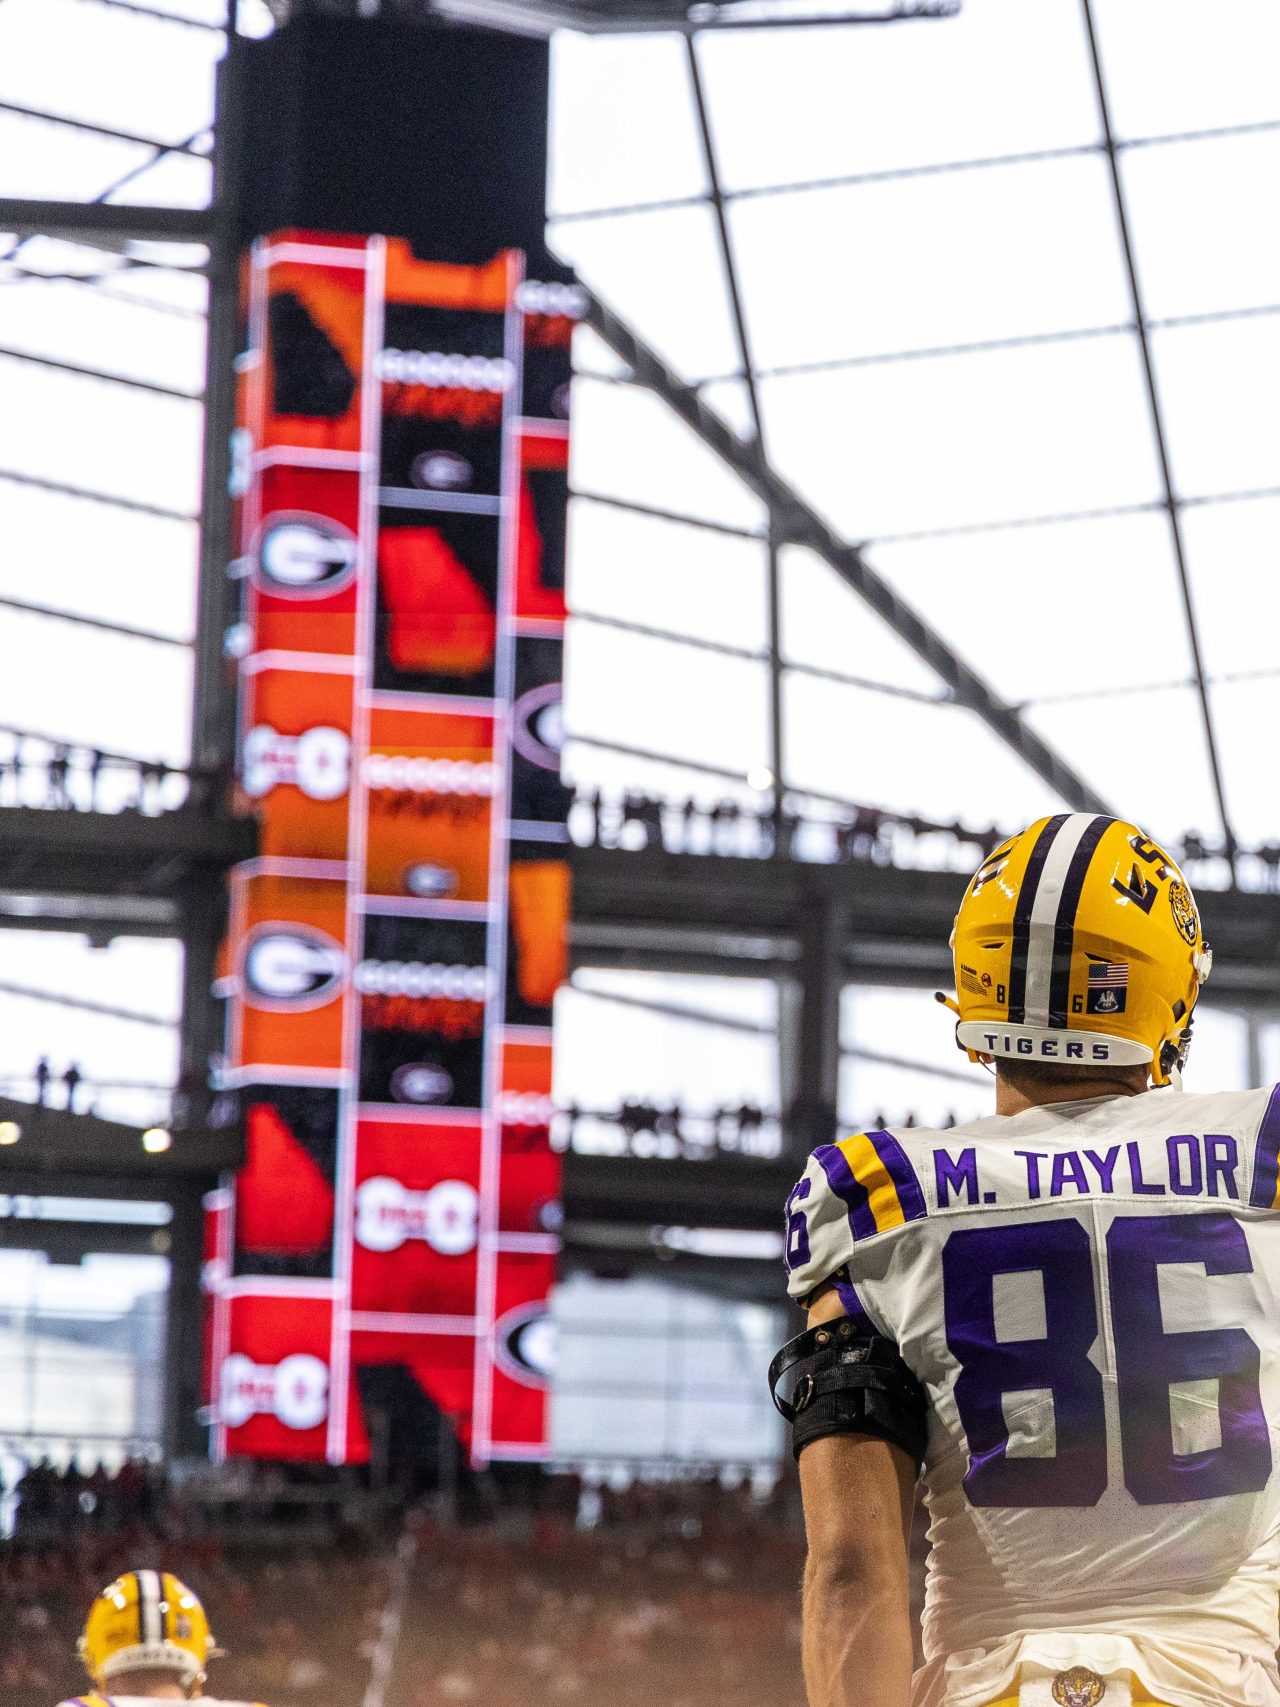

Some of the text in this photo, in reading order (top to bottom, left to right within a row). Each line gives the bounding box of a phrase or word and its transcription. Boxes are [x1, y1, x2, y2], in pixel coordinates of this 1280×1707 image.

[996, 984, 1006, 1004] 8
[983, 1034, 1110, 1060] TIGERS
[932, 1134, 1241, 1208] M. TAYLOR
[941, 1212, 1273, 1508] 86
